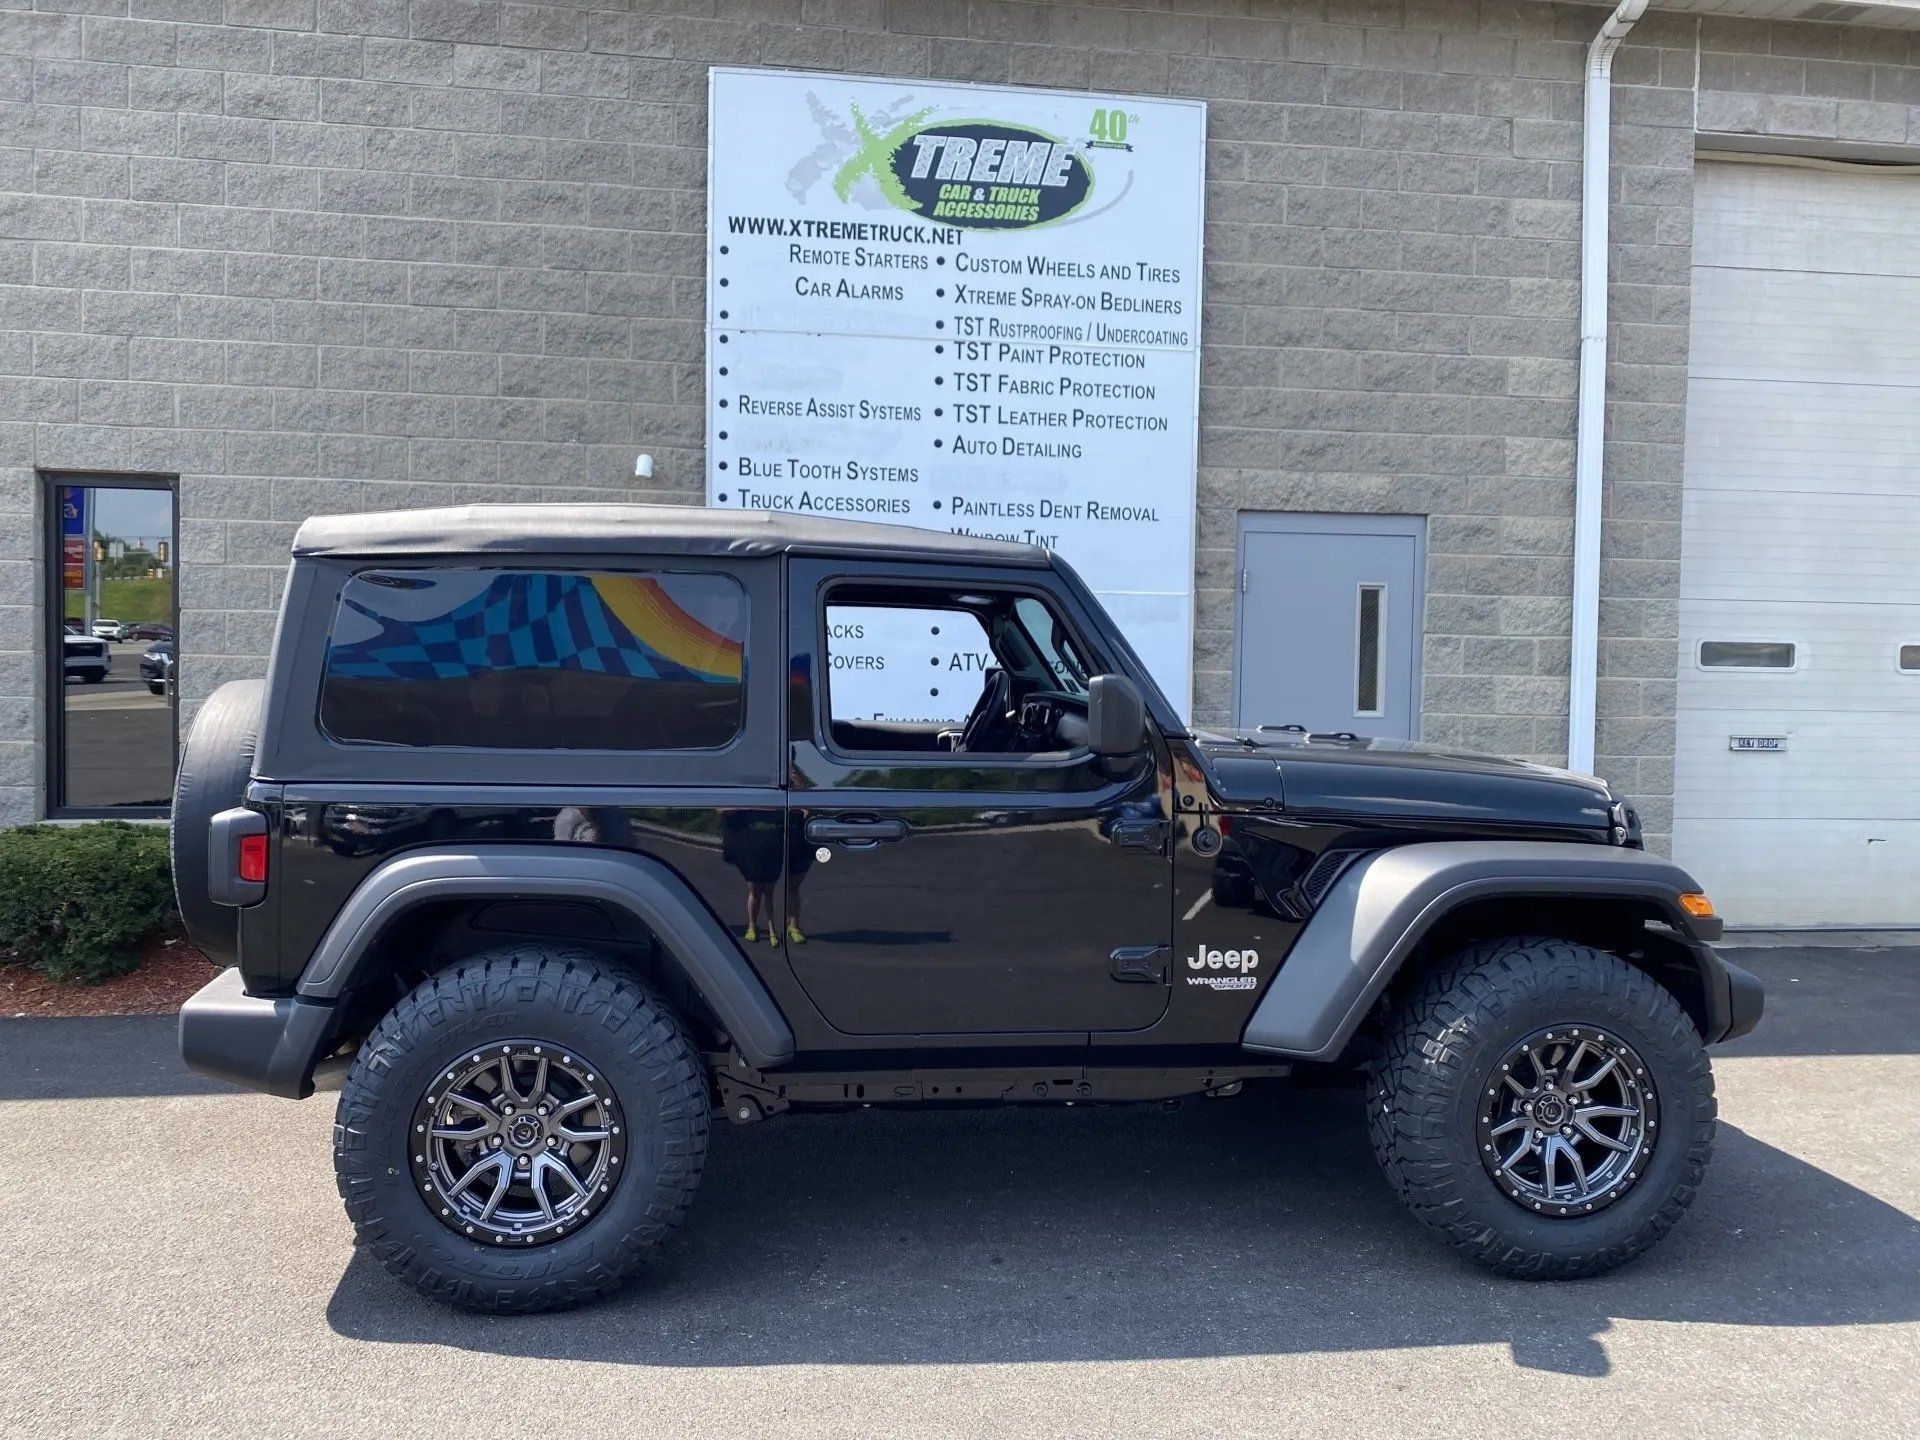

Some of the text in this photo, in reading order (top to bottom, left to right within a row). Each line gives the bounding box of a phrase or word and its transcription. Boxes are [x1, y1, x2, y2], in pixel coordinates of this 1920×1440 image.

[938, 184, 1040, 204] CAR & TRUCK
[933, 202, 1040, 221] ACCESSORIES
[729, 216, 964, 246] WWW.XTREMETRUCK.NET
[790, 244, 928, 269] REMOTE STARTERS
[956, 252, 1180, 283] CUSTOM WHEELS AND TIRES
[796, 277, 903, 300] CAR ALARMS
[955, 284, 1181, 314] XTREME SPRAY-ON BEDLINERS
[955, 316, 984, 336] TST
[990, 318, 1082, 340] RUSTPROOFING
[1097, 323, 1187, 345] UNDERCOATING
[954, 341, 1144, 368] TST PAINT PROTECTION
[954, 373, 1155, 399] TST FABRIC PROTECTION
[740, 395, 921, 420] REVERSE ASSIST SYSTEMS
[953, 404, 1167, 430] TST LEATHER PROTECTION
[953, 435, 1081, 458] AUTO DETAILING
[739, 457, 918, 482] BLUE TOOTH SYSTEMS
[738, 489, 910, 513] TRUCK ACCESSORIES
[952, 497, 1159, 521] PAINTLESS DENT REMOVAL
[1024, 530, 1058, 548] TINT
[827, 625, 864, 638] ACKS
[949, 653, 988, 671] ATV
[1739, 738, 1778, 748] KEY DROP
[1187, 944, 1259, 974] Jeep
[1186, 976, 1257, 985] WRANGLER
